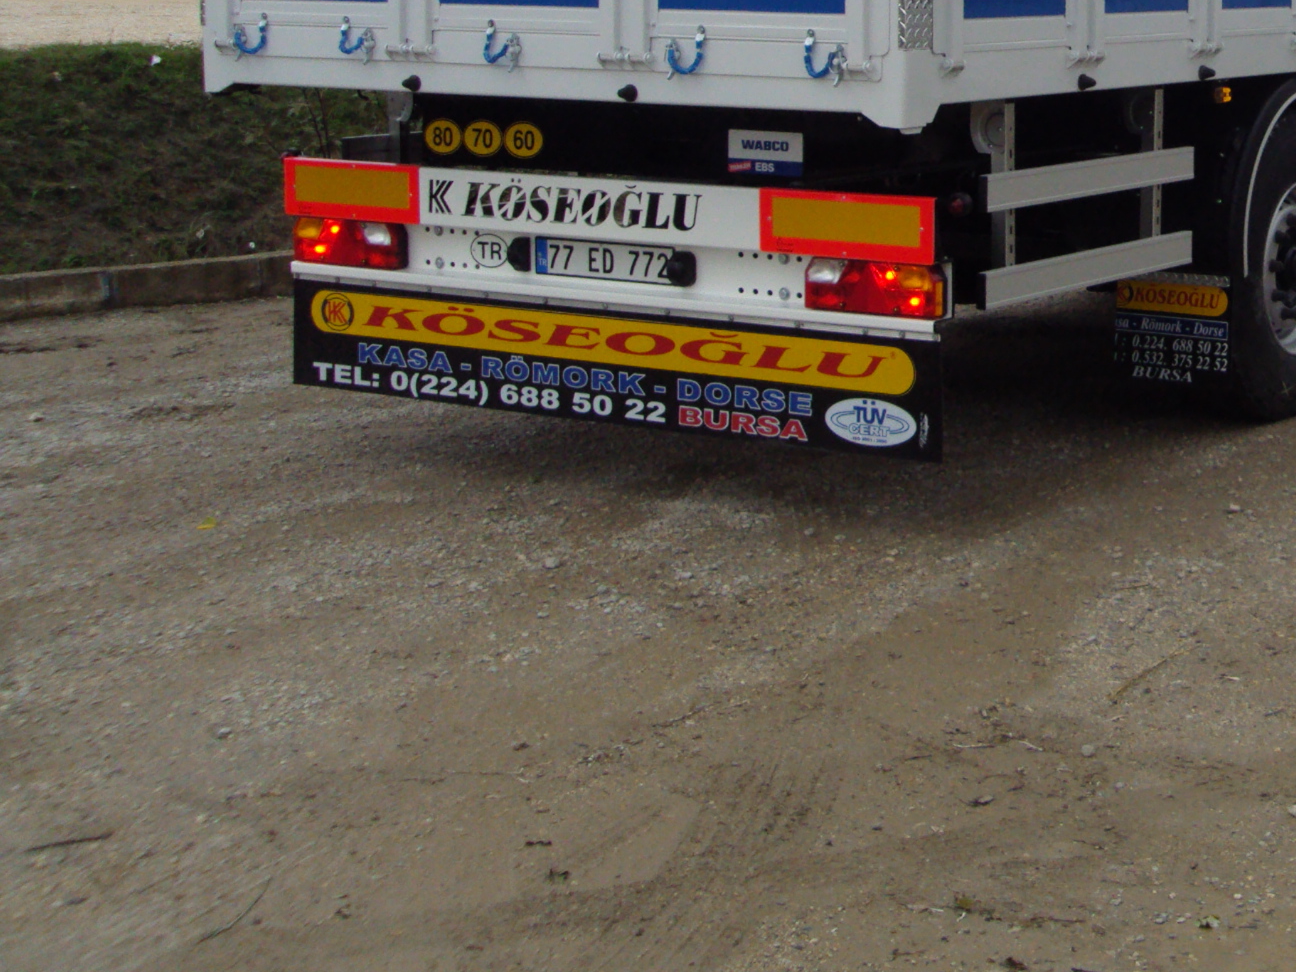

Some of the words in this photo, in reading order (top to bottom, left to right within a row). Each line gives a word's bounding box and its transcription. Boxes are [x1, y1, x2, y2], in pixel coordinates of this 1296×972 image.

[433, 126, 453, 147] 80
[472, 128, 493, 149] 70
[513, 130, 535, 150] 60
[741, 139, 789, 152] WABCO
[755, 161, 775, 173] EBS
[461, 178, 702, 231] KÖSEOĞLU
[477, 241, 502, 260] TR
[549, 244, 574, 270] 77
[588, 247, 614, 274] ED
[628, 250, 669, 278] 772
[1135, 284, 1220, 309] KÖSEOĞLU
[1141, 317, 1182, 333] Römork
[1193, 322, 1224, 337] Dorse
[362, 306, 887, 378] KÖSEOĞLU
[1172, 339, 1193, 353] 688
[1197, 341, 1211, 355] 50
[1214, 343, 1228, 356] 22
[1171, 354, 1193, 368] 375
[1196, 357, 1210, 370] 22
[1213, 358, 1228, 372] 52
[357, 342, 453, 373] KASA
[460, 362, 472, 371] -
[481, 355, 646, 396] RÖMORK
[654, 385, 667, 394] -
[677, 378, 813, 416] DORSE
[1132, 365, 1192, 383] BURSA
[313, 362, 380, 388] TEL:
[390, 370, 489, 405] 0(224)
[500, 383, 560, 410] 688
[572, 392, 613, 417] 50
[625, 398, 667, 423] 22
[678, 405, 808, 442] BURSA
[853, 399, 886, 425] TÜV
[849, 423, 890, 437] CERT
